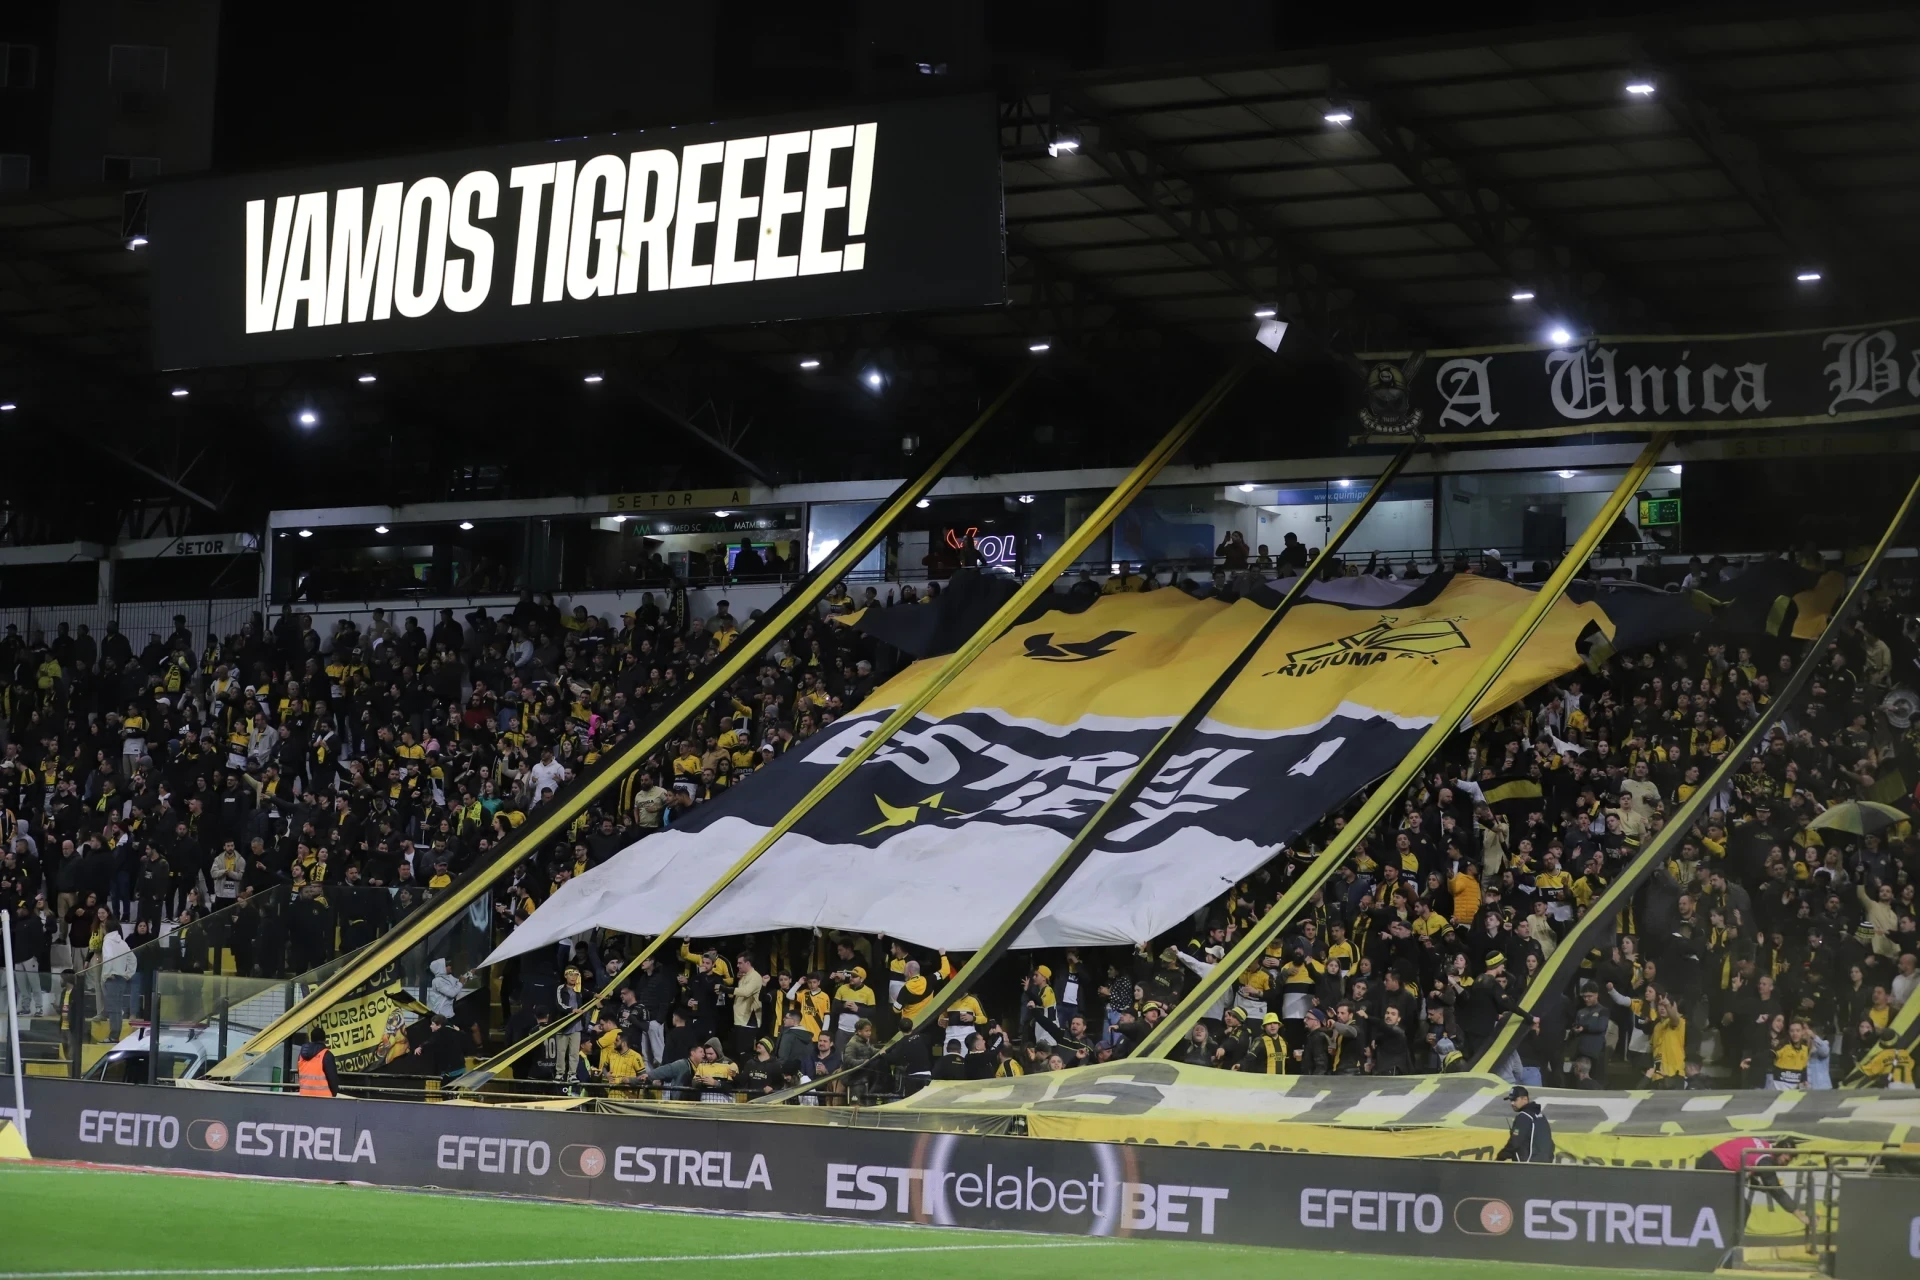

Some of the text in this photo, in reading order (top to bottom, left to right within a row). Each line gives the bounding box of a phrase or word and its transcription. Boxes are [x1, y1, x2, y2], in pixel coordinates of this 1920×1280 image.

[246, 122, 878, 334] VAMOS TIGREEEE!
[1436, 355, 1501, 428] A
[617, 490, 740, 509] SETOR A
[658, 523, 702, 533] MATMED SC
[734, 521, 766, 530] MATMED
[175, 540, 224, 556] SETOR
[324, 1024, 375, 1050] ERVEJA
[543, 1037, 556, 1059] 10
[336, 1052, 379, 1073] RICIÚMA
[1279, 1074, 1920, 1143] TIGRE
[79, 1108, 377, 1164] EFEITO ESTRELA
[436, 1134, 772, 1192] EFEITO ESTRELA
[1121, 1182, 1229, 1235] BET
[1300, 1187, 1725, 1249] EFEITO ESTRELA
